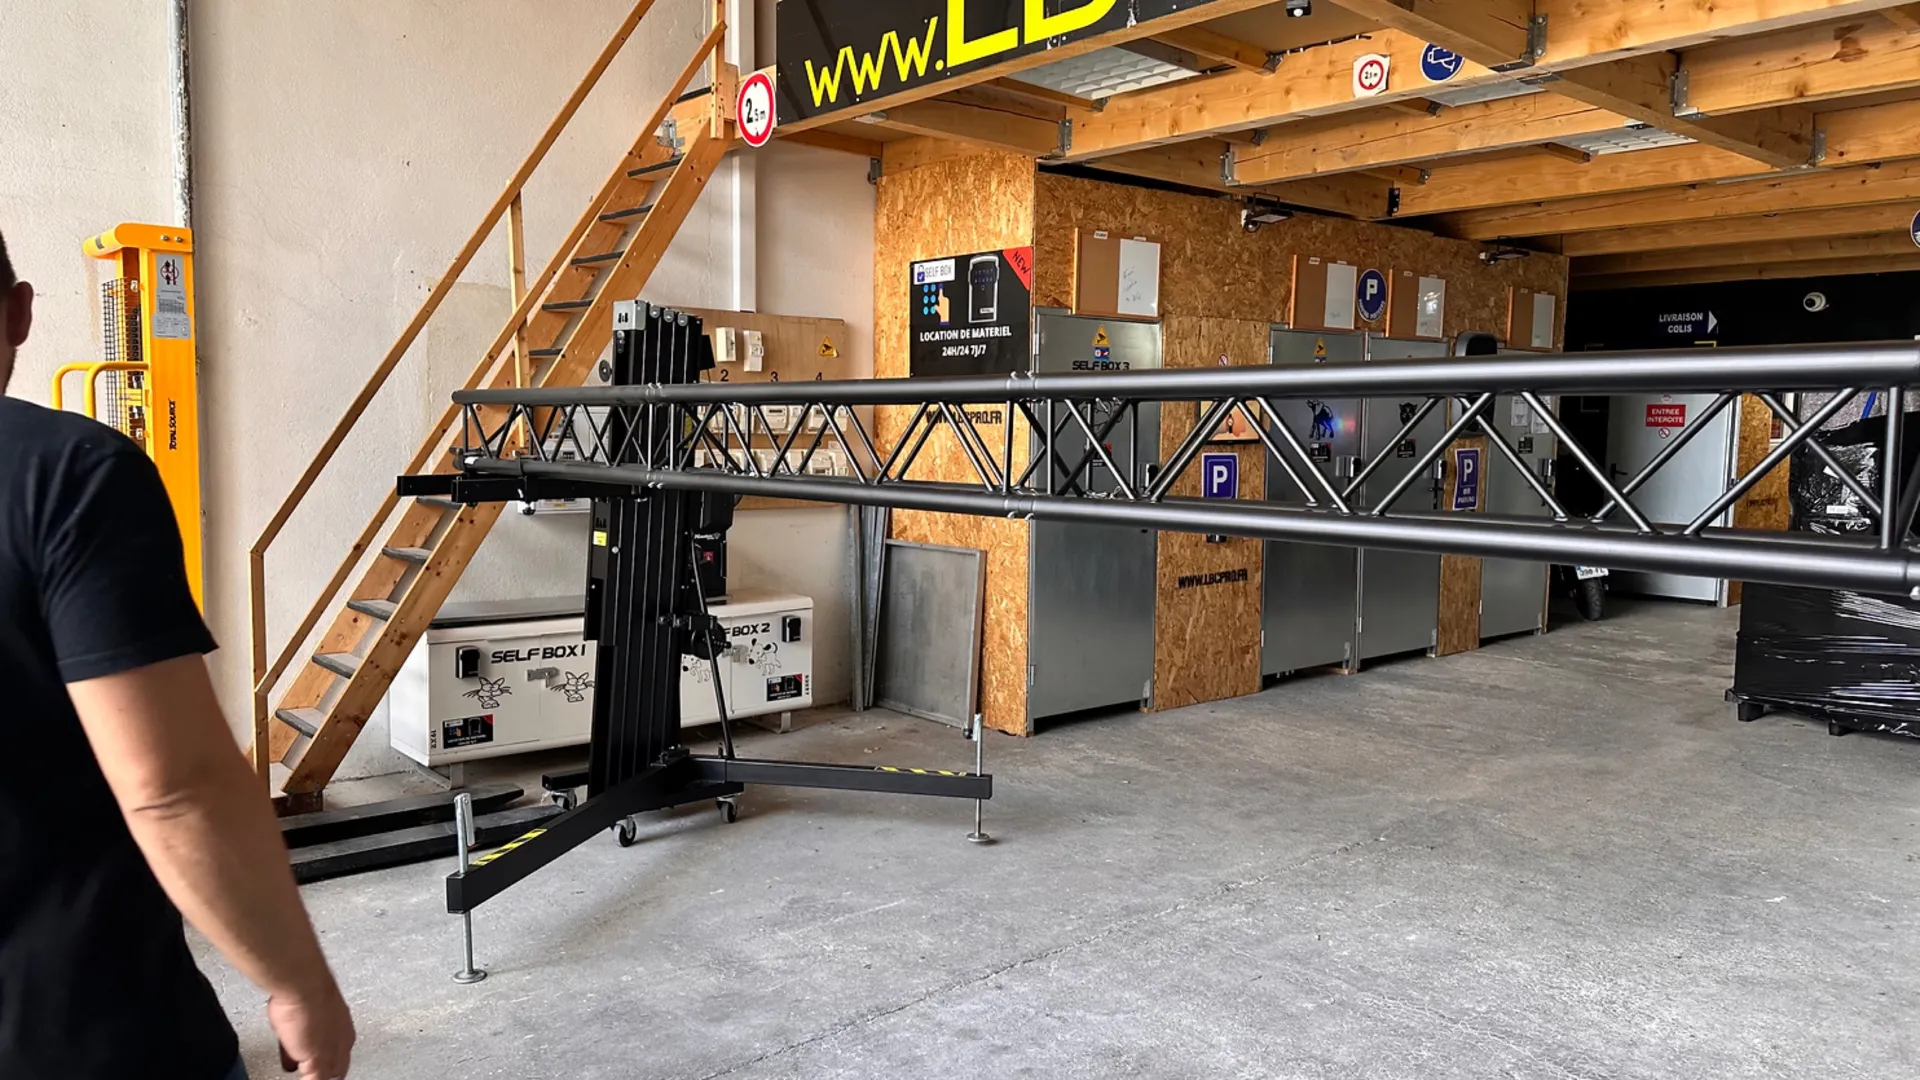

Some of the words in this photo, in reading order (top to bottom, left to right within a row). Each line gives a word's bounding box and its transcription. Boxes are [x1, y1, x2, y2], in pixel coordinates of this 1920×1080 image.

[1012, 251, 1031, 275] NEW
[925, 266, 939, 278] SELF
[1366, 278, 1378, 301] P
[1659, 312, 1704, 323] LIVRAISON
[920, 329, 959, 342] LOCATION
[960, 328, 971, 339] DE
[971, 325, 1013, 339] MATERIEL
[1667, 324, 1693, 334] COLIS
[942, 345, 970, 357] 24H/24
[720, 369, 729, 382] 2
[770, 371, 779, 382] 3
[1463, 458, 1473, 482] P
[1213, 465, 1228, 494] P
[732, 624, 759, 637] BOX
[761, 622, 770, 633] 2
